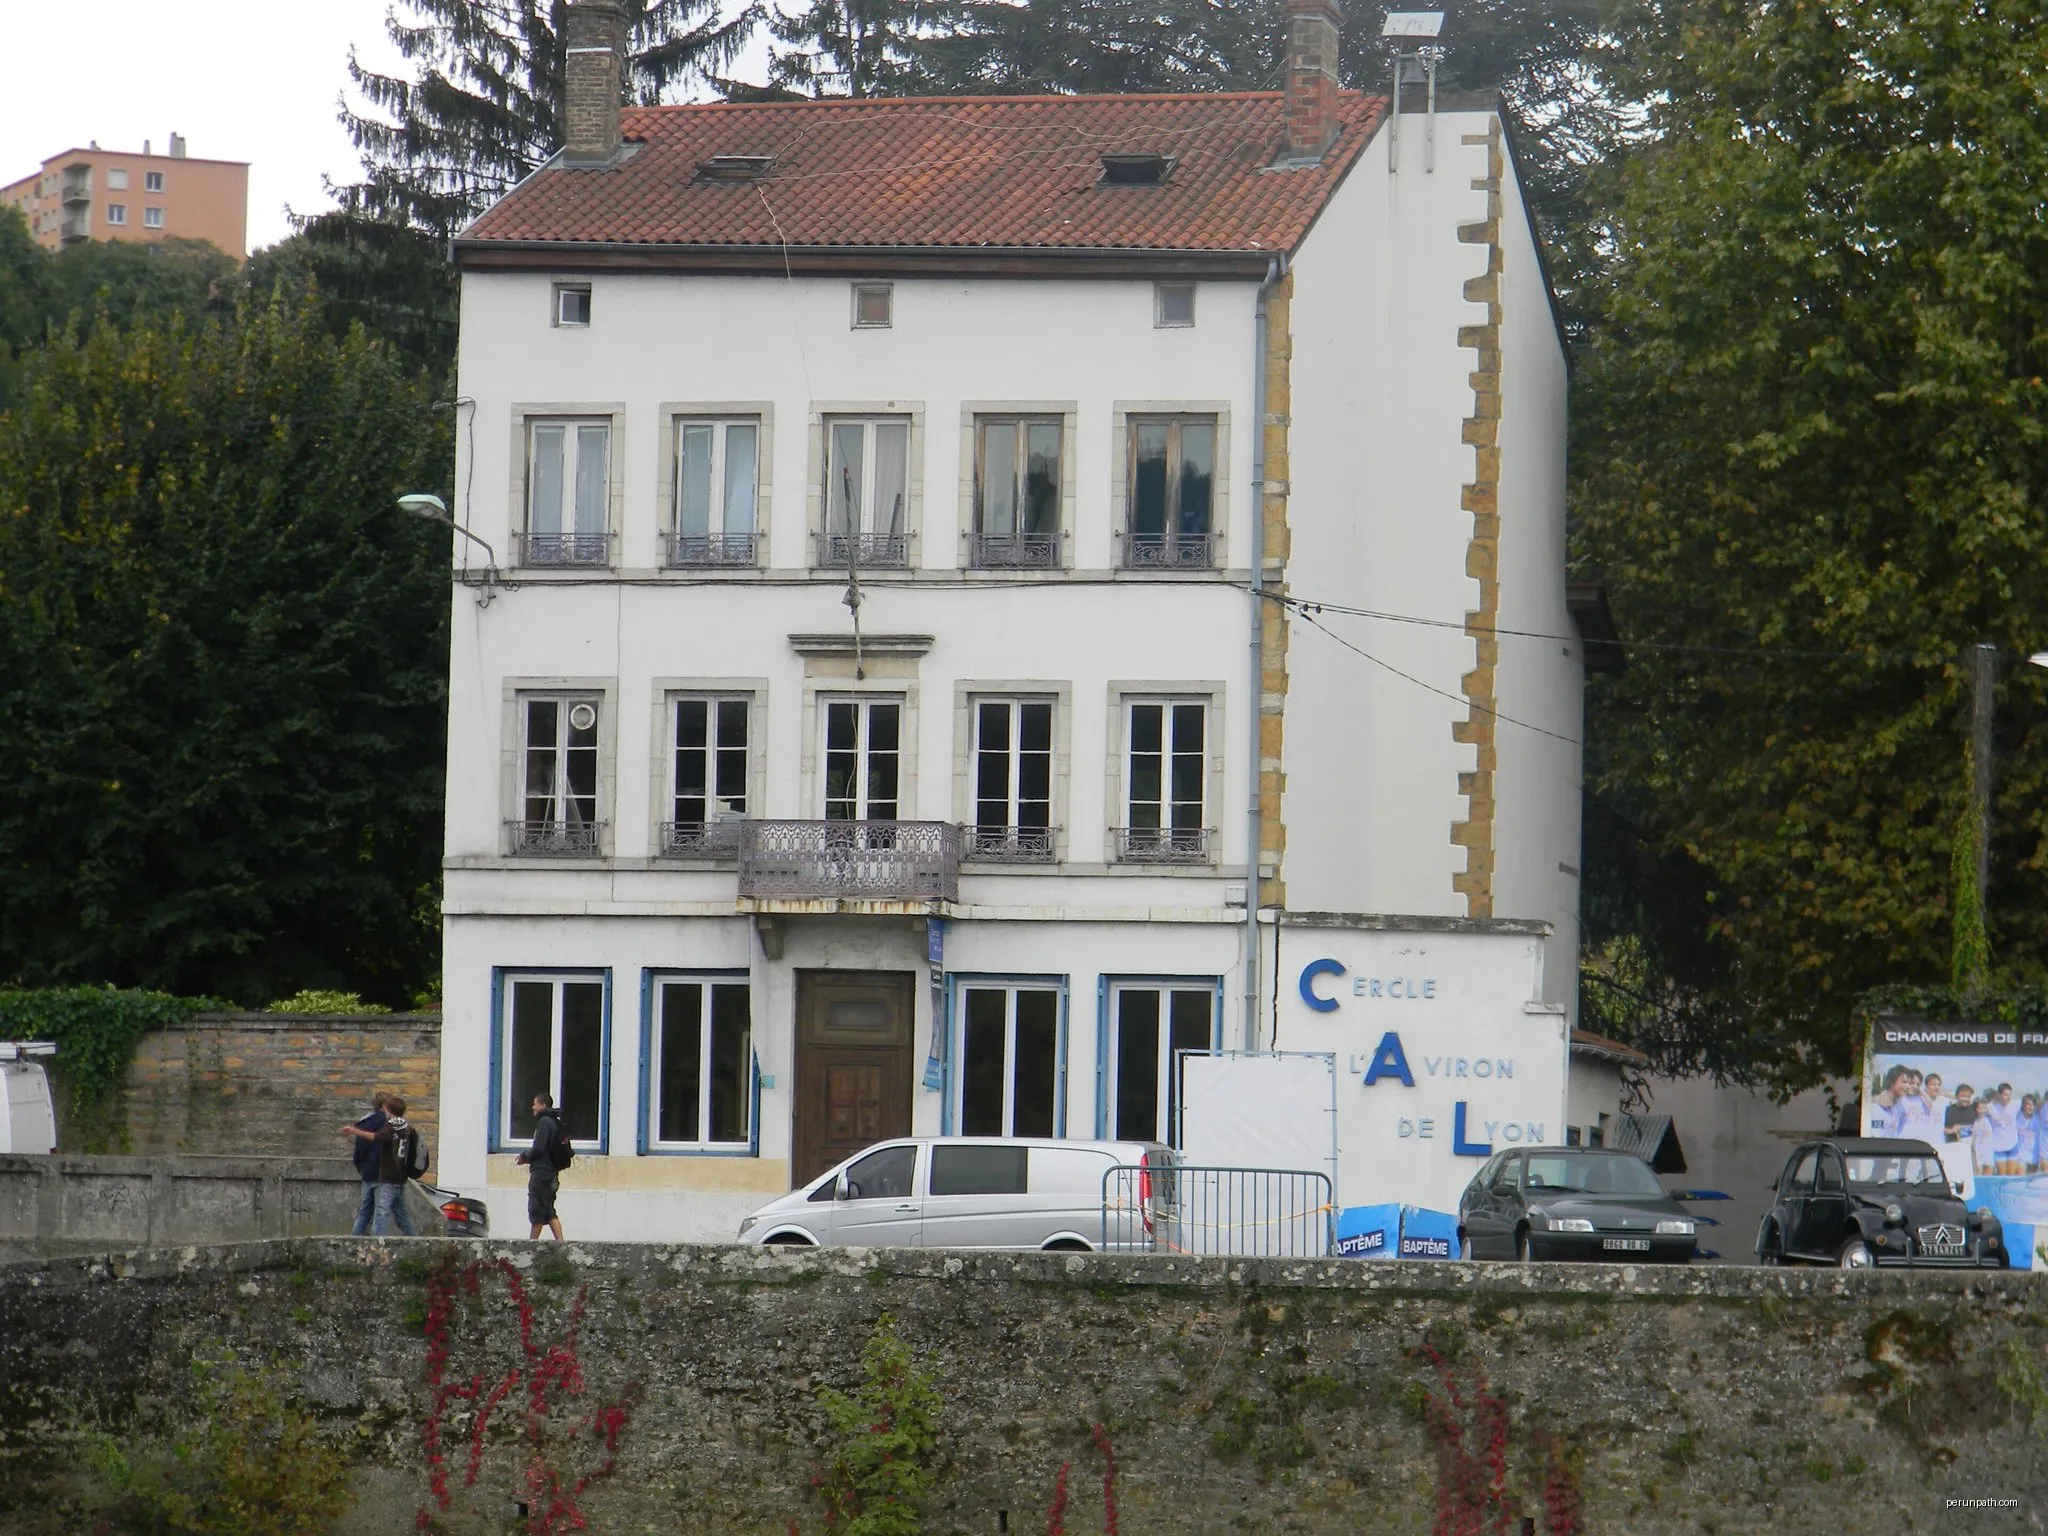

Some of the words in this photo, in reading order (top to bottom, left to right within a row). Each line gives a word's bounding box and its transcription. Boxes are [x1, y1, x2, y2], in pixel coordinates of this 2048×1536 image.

[1298, 958, 1437, 1013] CERCLE
[1885, 1031, 1989, 1044] CHAMPIONS
[1993, 1033, 2017, 1044] DE
[1398, 1118, 1435, 1139] DE
[1453, 1100, 1545, 1157] LYON
[1332, 1233, 1383, 1256] APTÊME
[1403, 1238, 1449, 1256] BAPTÊME
